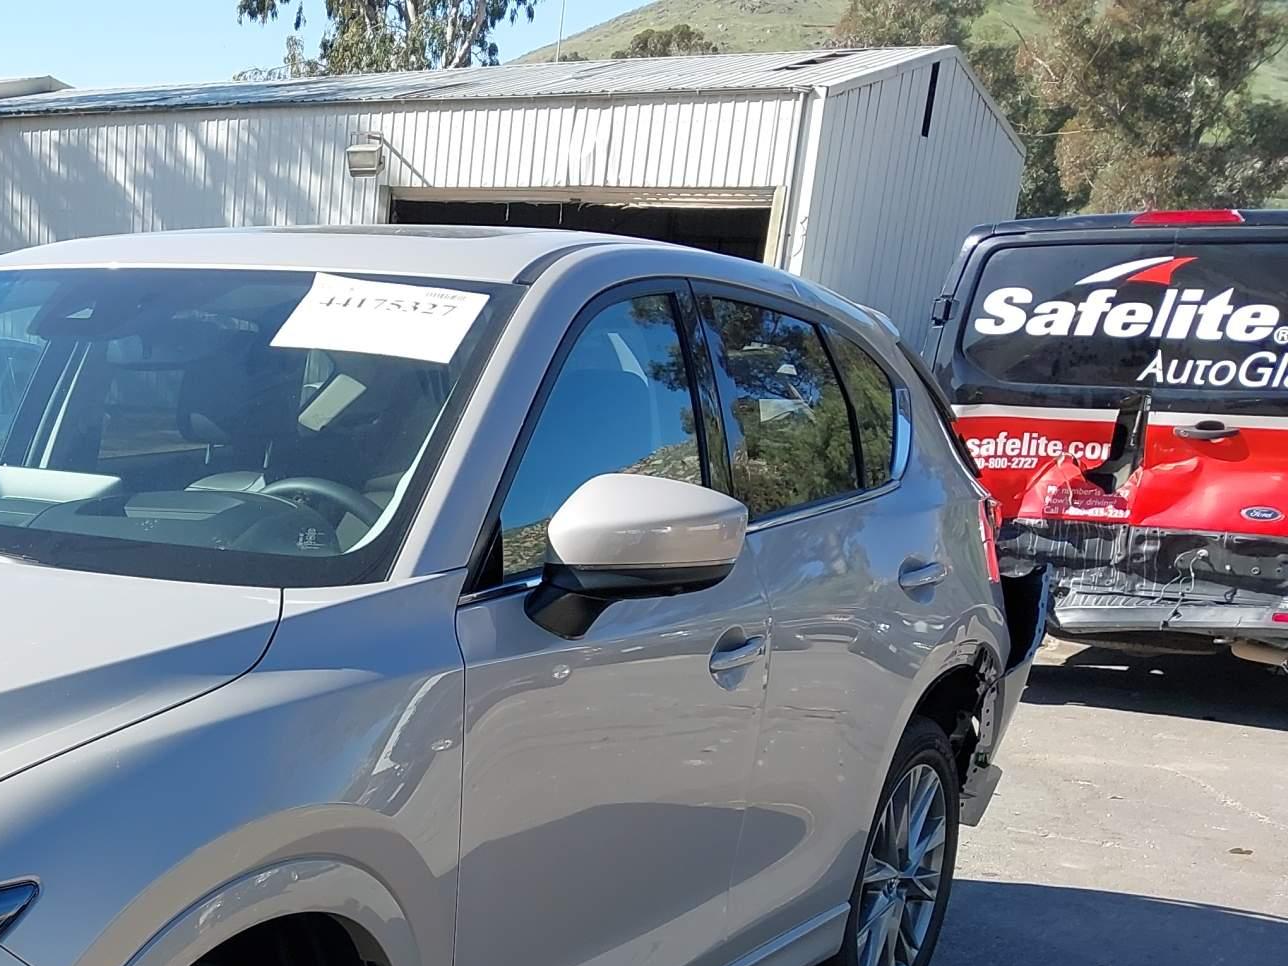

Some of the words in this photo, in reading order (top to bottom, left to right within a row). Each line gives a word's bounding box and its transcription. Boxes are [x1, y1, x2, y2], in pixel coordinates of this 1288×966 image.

[319, 296, 458, 317] 44175327
[1136, 349, 1288, 388] AutoGl
[1044, 505, 1059, 514] Call
